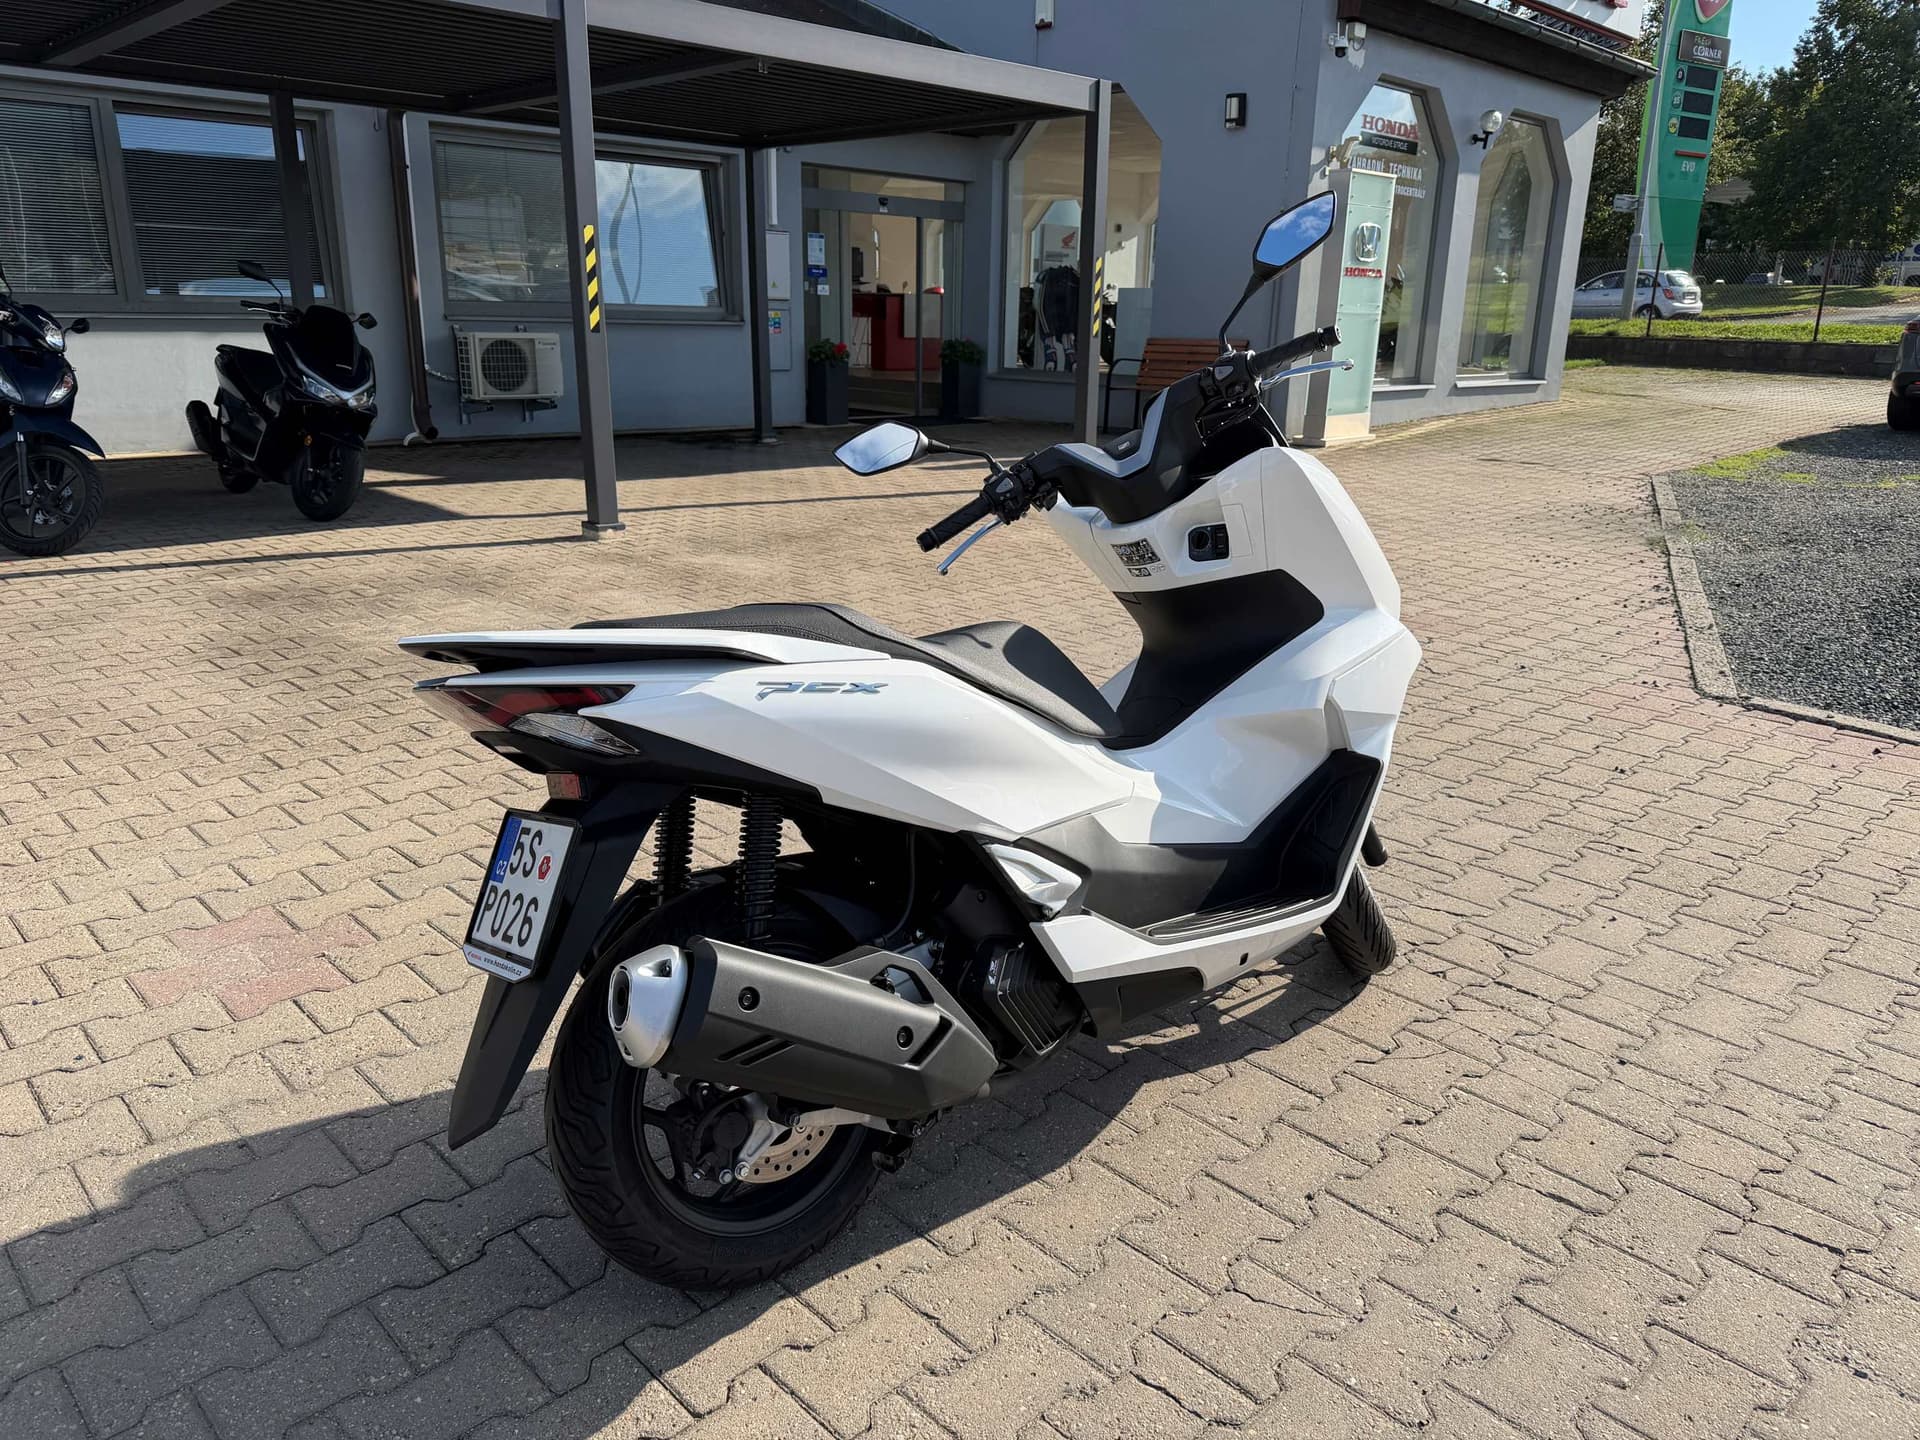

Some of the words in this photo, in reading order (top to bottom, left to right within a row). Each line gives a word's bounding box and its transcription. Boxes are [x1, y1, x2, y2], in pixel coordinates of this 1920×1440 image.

[1692, 45, 1722, 60] CORNER
[1361, 113, 1419, 140] HONDA
[1389, 162, 1422, 180] TECHNIKA
[1681, 160, 1696, 172] EVO
[1344, 266, 1383, 279] HONDA
[755, 681, 889, 701] PCX
[509, 826, 543, 878] 5S
[496, 860, 507, 876] CZ
[476, 884, 539, 948] P026
